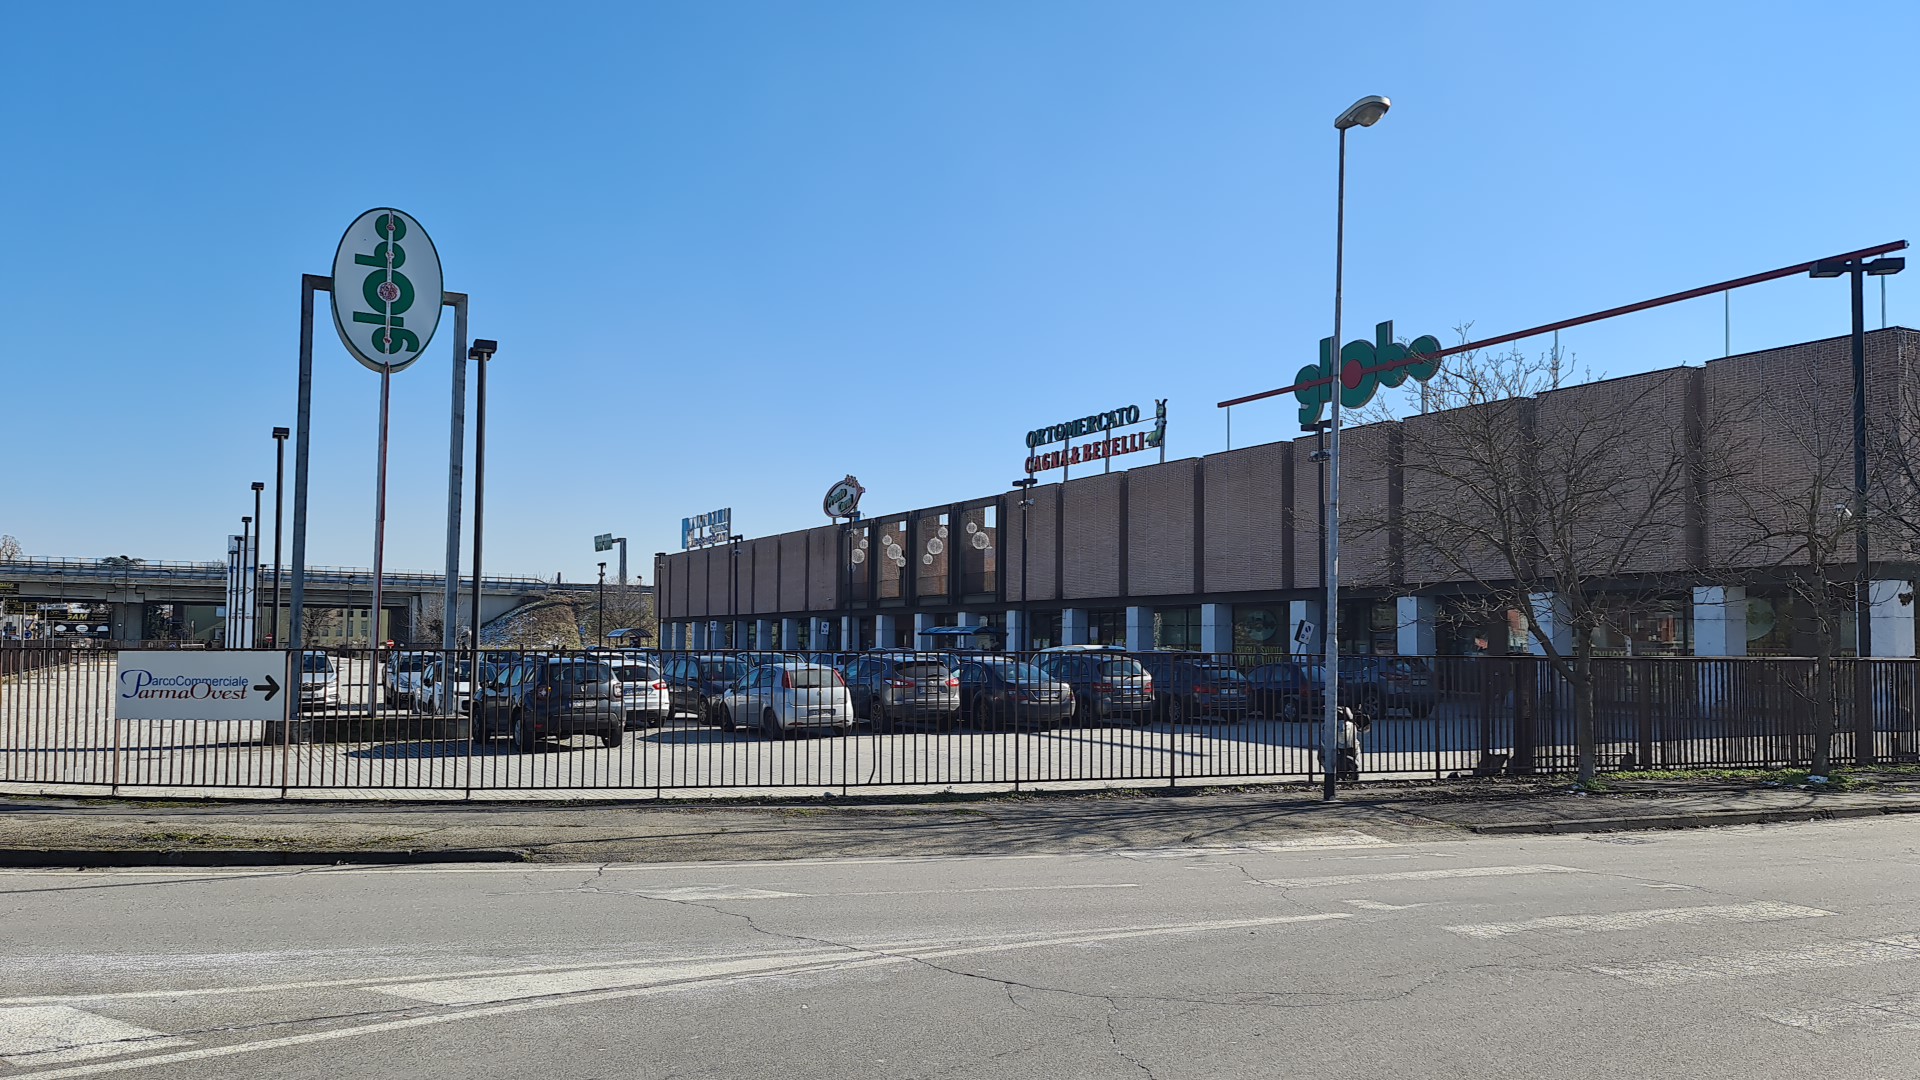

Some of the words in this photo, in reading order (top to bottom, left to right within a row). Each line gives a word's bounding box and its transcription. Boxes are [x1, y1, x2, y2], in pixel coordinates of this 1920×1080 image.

[353, 213, 420, 355] globe
[1294, 319, 1442, 426] globe
[1024, 448, 1068, 474] CAGNA
[1082, 431, 1145, 463] BENELLI
[1025, 404, 1140, 449] ORTOMERCATO
